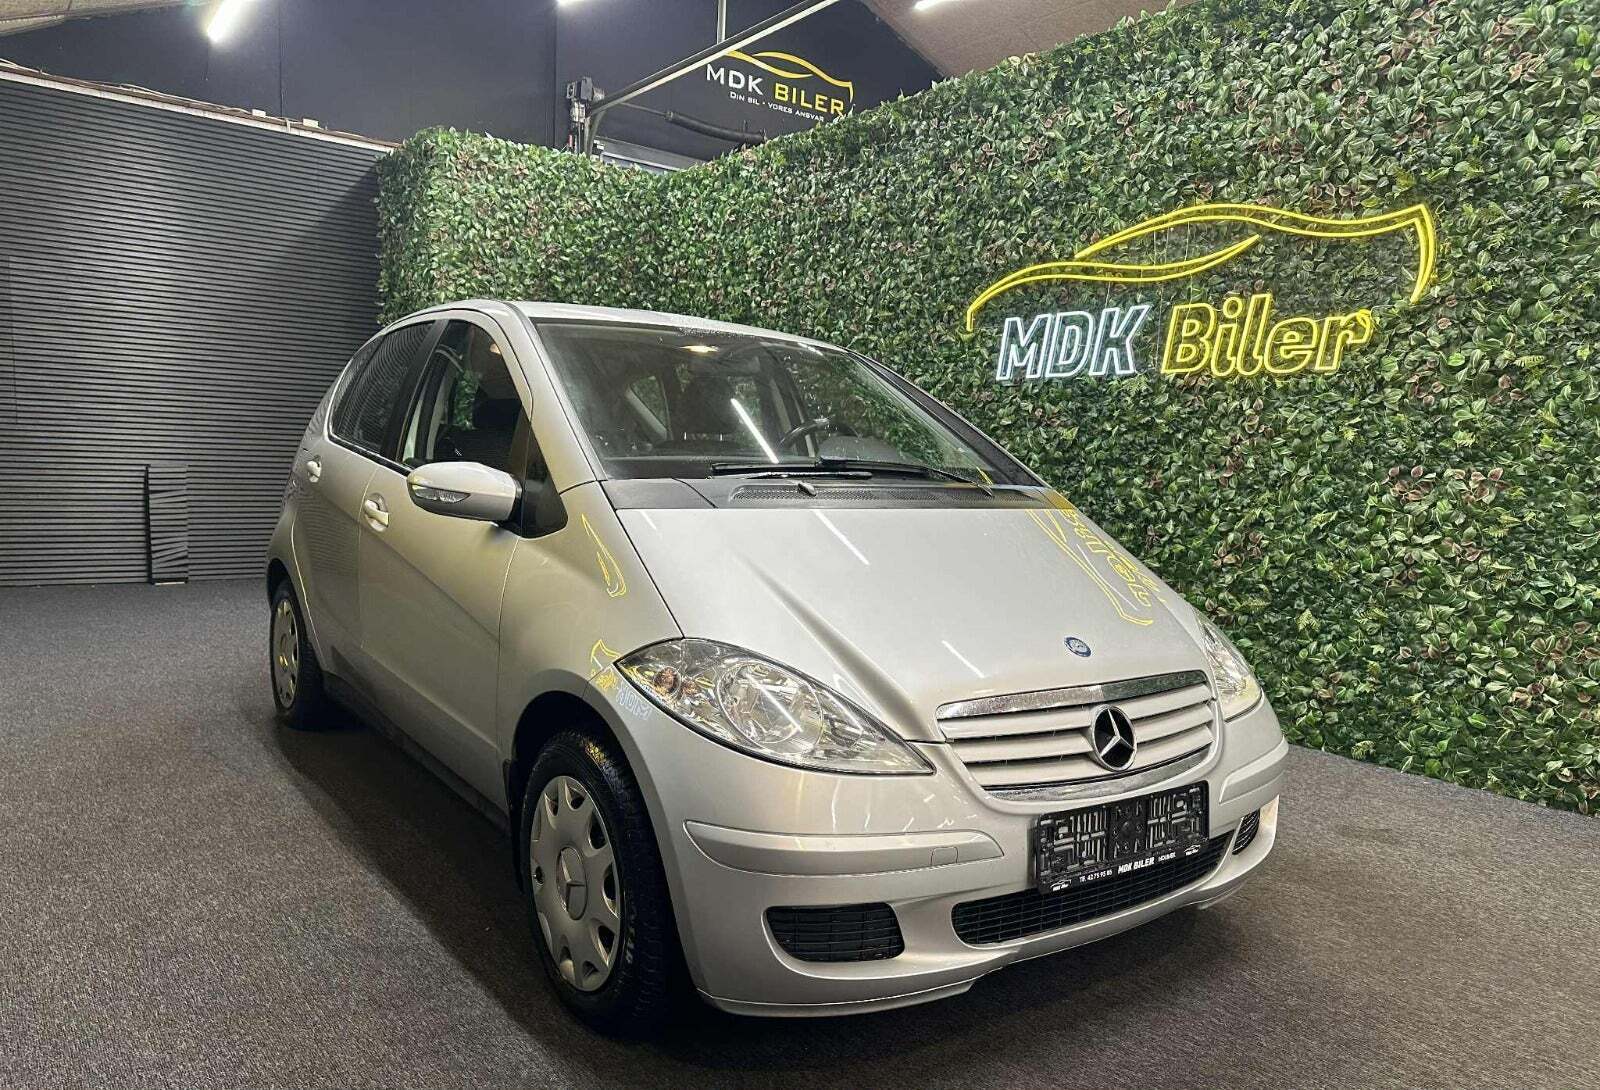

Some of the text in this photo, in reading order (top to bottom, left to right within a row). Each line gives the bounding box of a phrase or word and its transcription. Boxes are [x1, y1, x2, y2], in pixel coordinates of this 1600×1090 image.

[706, 63, 846, 119] MDK BILER
[747, 96, 760, 106] BIL
[767, 102, 793, 115] VORES
[794, 110, 825, 123] ANSVAR
[995, 292, 1374, 382] MDK Biler
[1117, 861, 1133, 875] MDK
[1133, 856, 1155, 870] BILER
